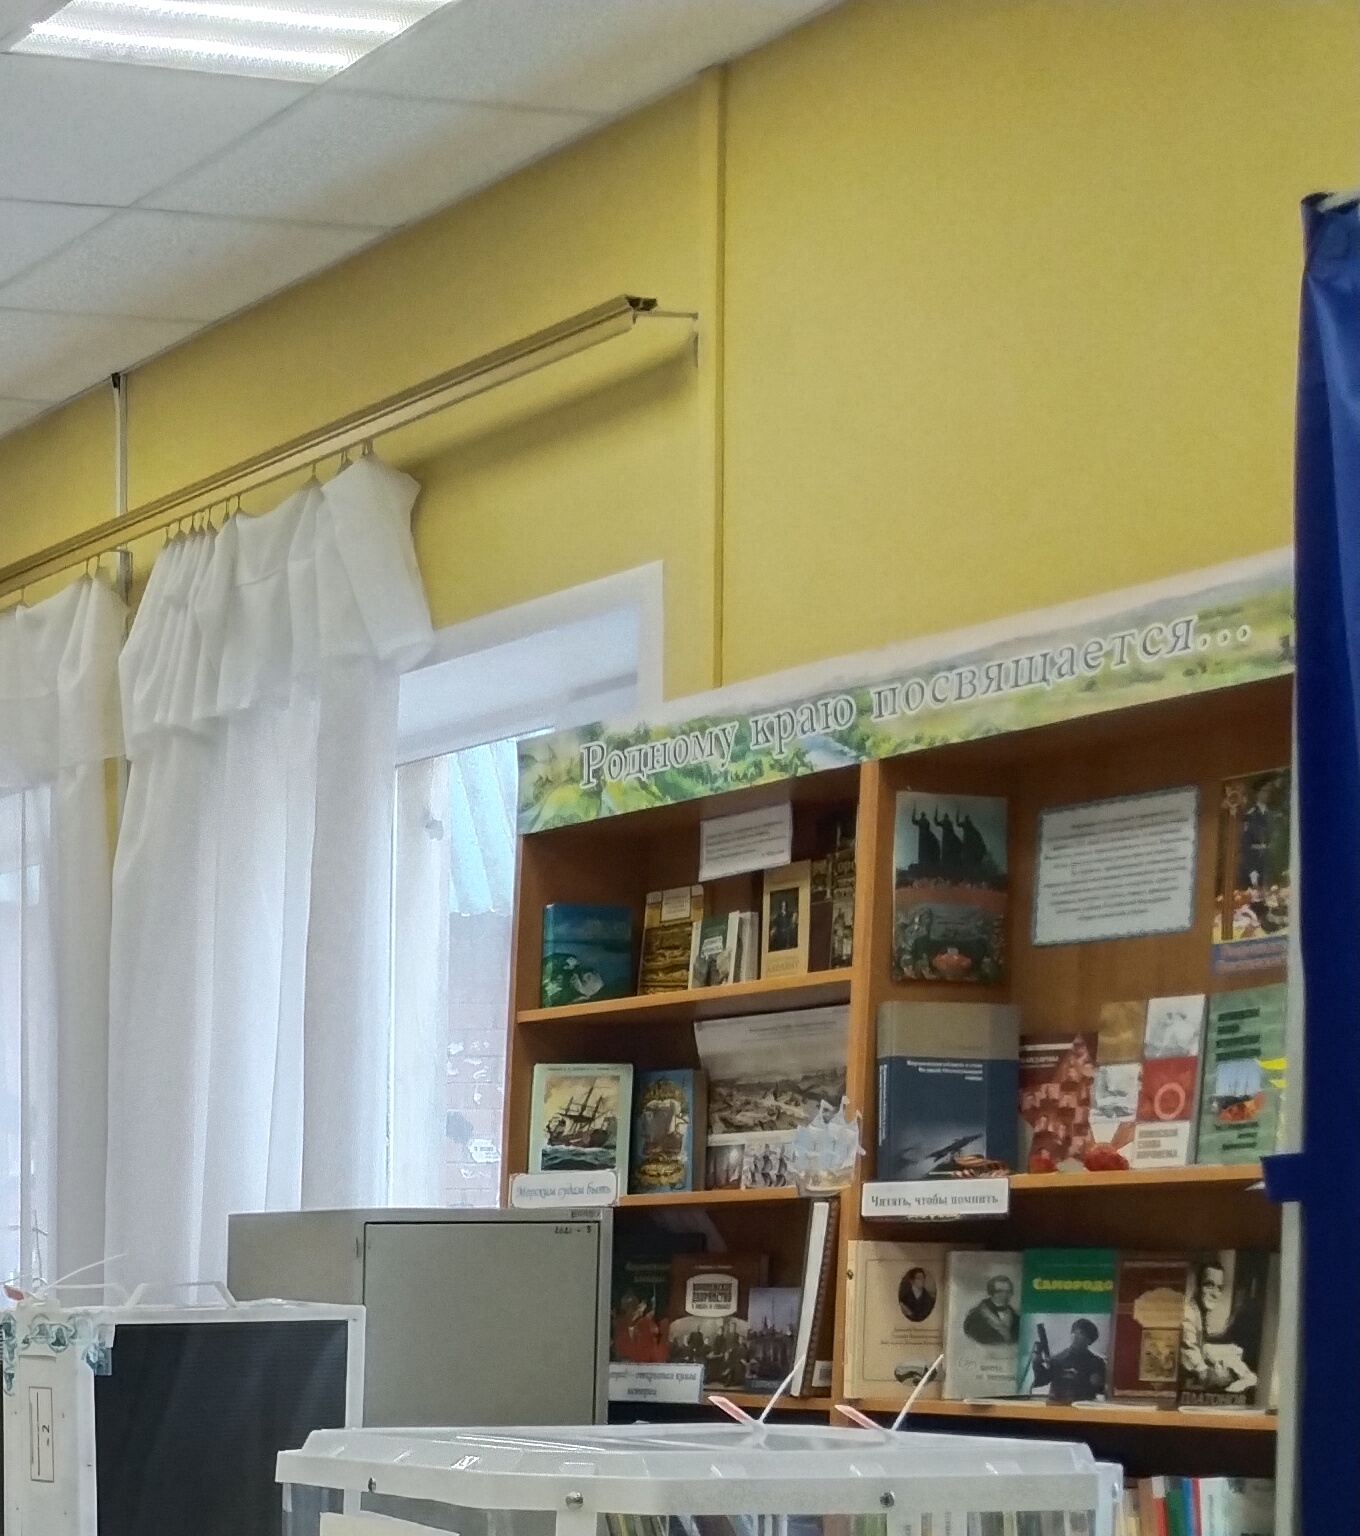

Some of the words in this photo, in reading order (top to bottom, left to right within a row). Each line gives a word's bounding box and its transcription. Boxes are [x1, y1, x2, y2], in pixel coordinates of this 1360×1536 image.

[580, 722, 737, 789] Родному
[750, 695, 855, 763] краю
[872, 613, 1251, 723] посвящается...
[872, 1195, 911, 1207] Читать,
[915, 1193, 947, 1206] чтобы
[951, 1194, 998, 1205] помнить
